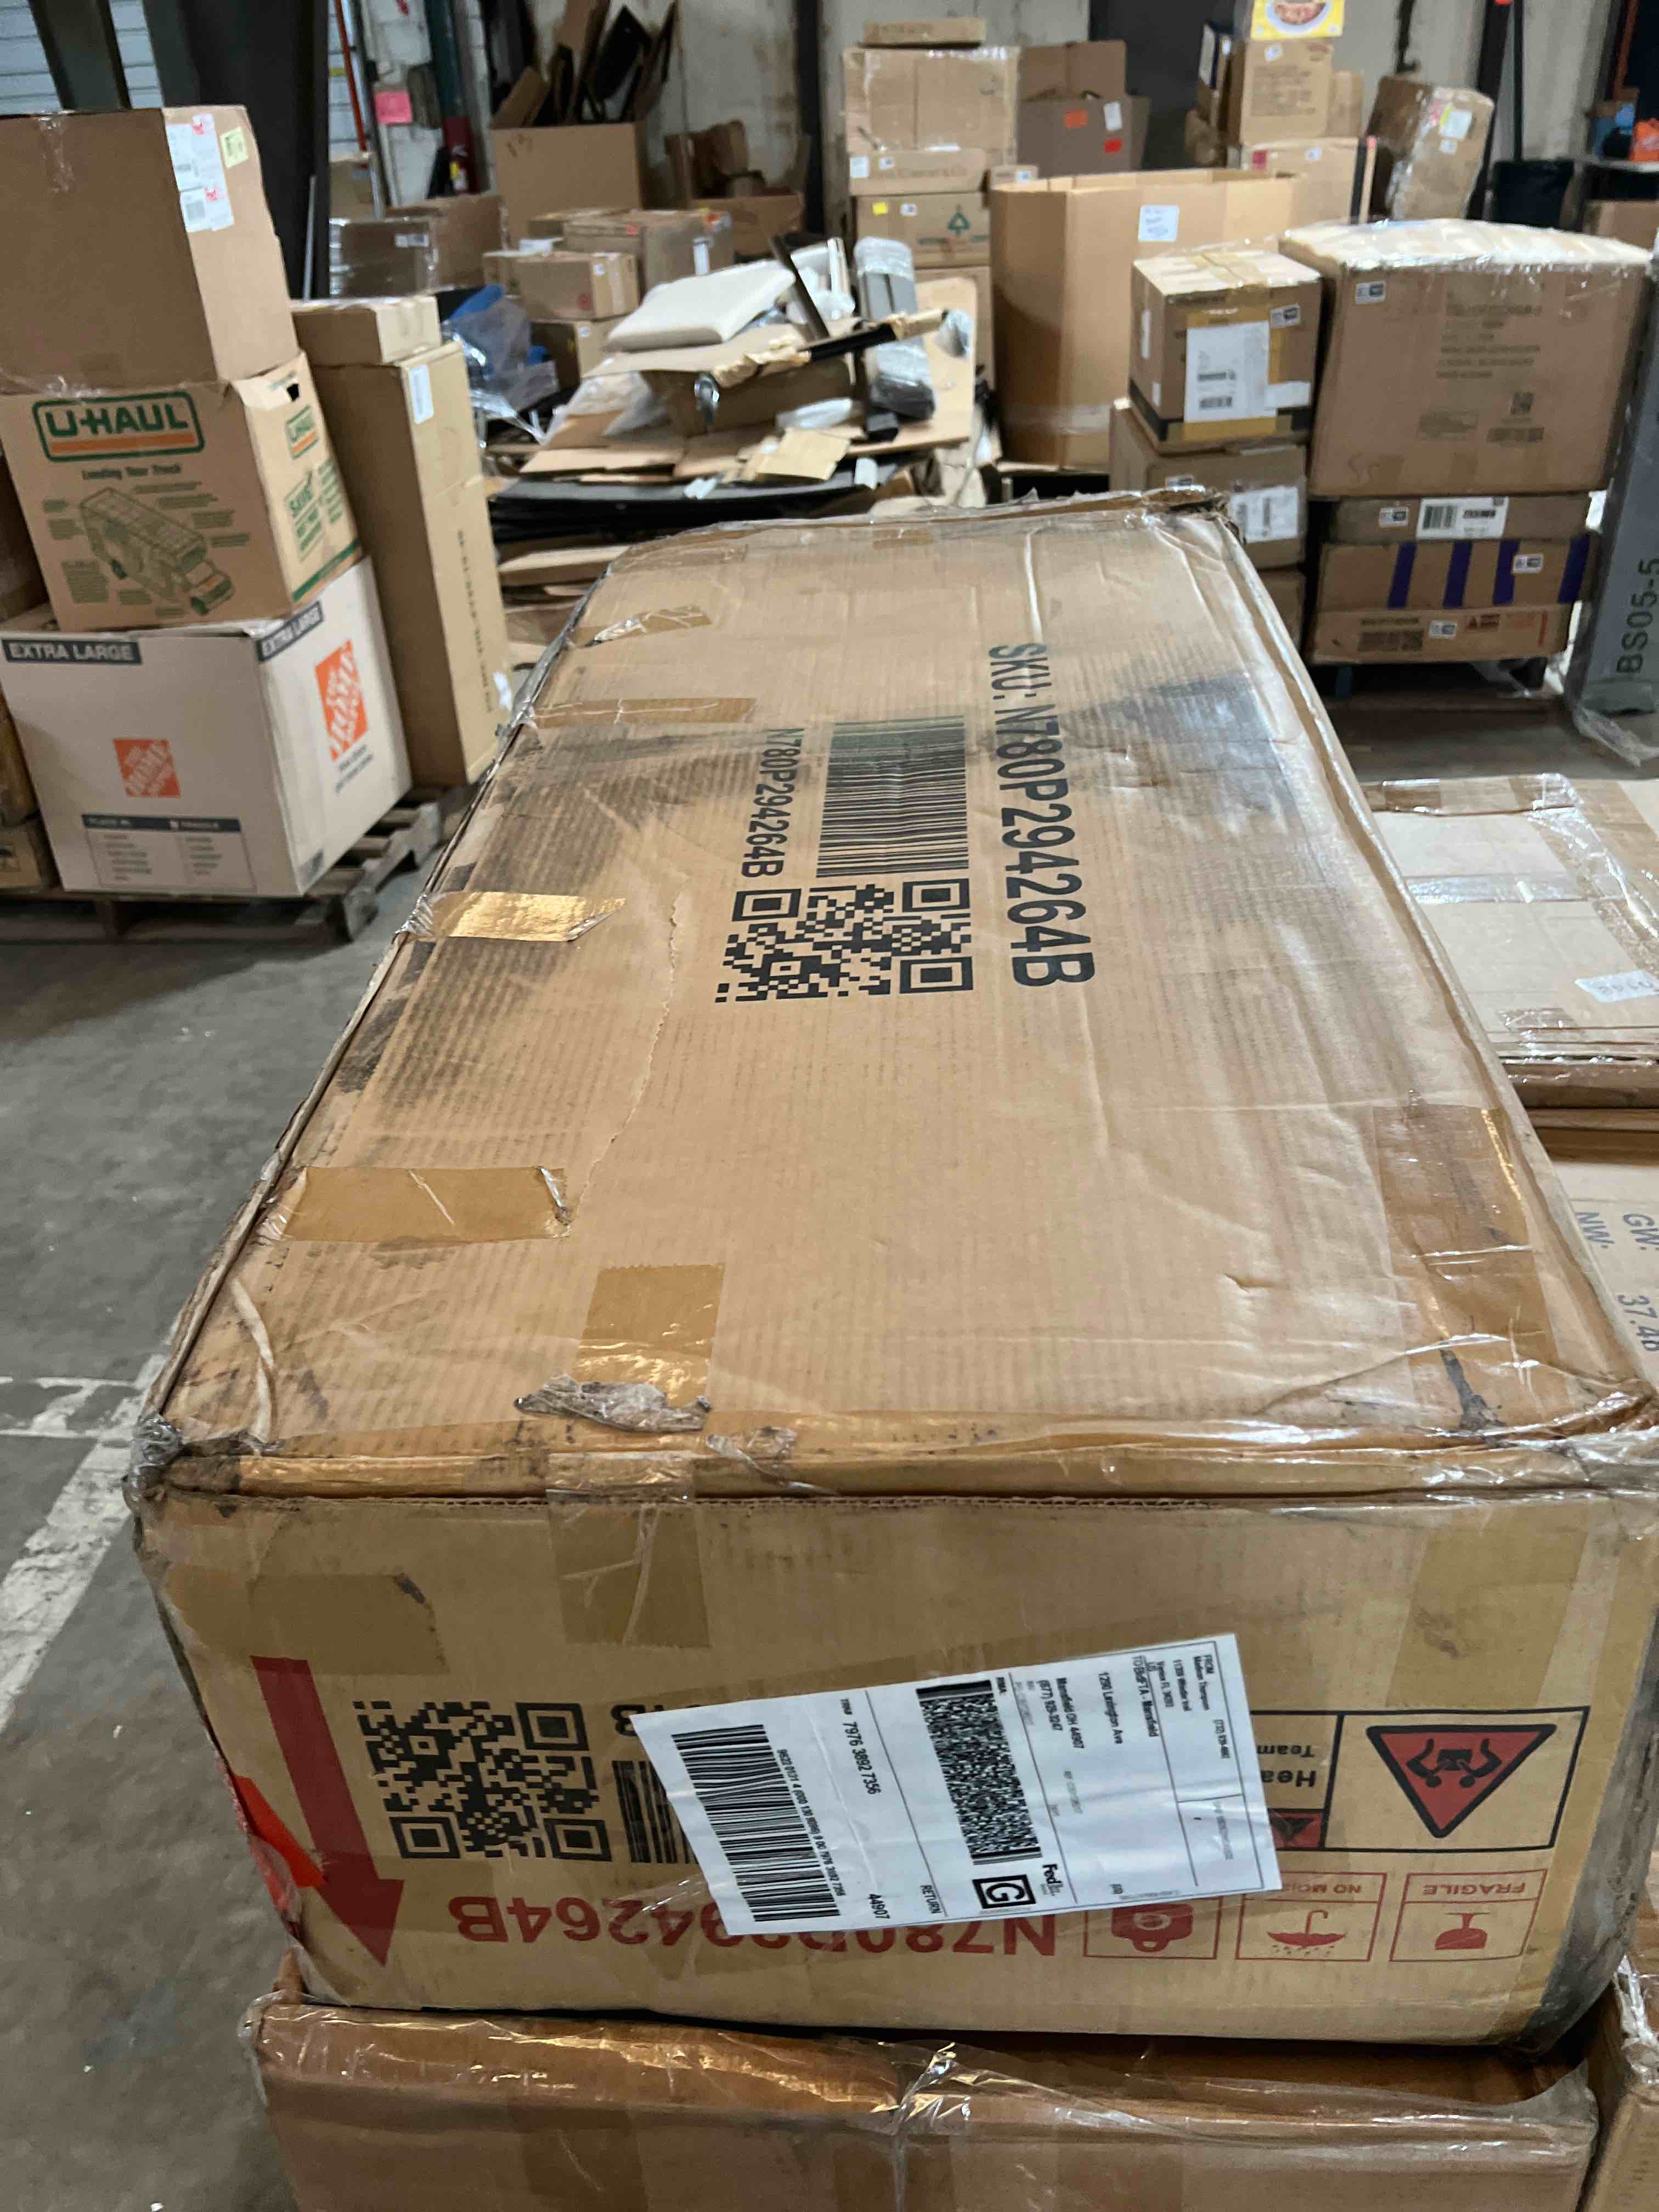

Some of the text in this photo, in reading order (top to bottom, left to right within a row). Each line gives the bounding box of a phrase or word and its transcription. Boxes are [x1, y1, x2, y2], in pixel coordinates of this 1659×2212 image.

[46, 404, 188, 437] U-HAUL
[1616, 557, 1659, 674] BS05-5
[10, 643, 134, 661] EXTRA LARGE
[741, 727, 805, 879] N780P294264B
[989, 642, 1095, 987] SKU: N780P294264B
[1055, 1677, 1075, 1712] Mansfield
[1064, 1712, 1079, 1725] OH
[1099, 1690, 1121, 1728] Lexington
[1111, 1729, 1126, 1745] Ave
[1141, 1700, 1160, 1737] Mansfield
[841, 1721, 864, 1747] 7976
[1068, 1726, 1085, 1750] 44907
[851, 1747, 873, 1771] 3892
[860, 1772, 882, 1795] 7356
[1261, 1770, 1316, 1788] Hea
[919, 1884, 942, 1914] RETURN
[982, 1881, 1027, 1903] G
[1334, 1883, 1362, 1894] NO
[1422, 1882, 1526, 1894] FRAGILE
[865, 1893, 891, 1920] 44907
